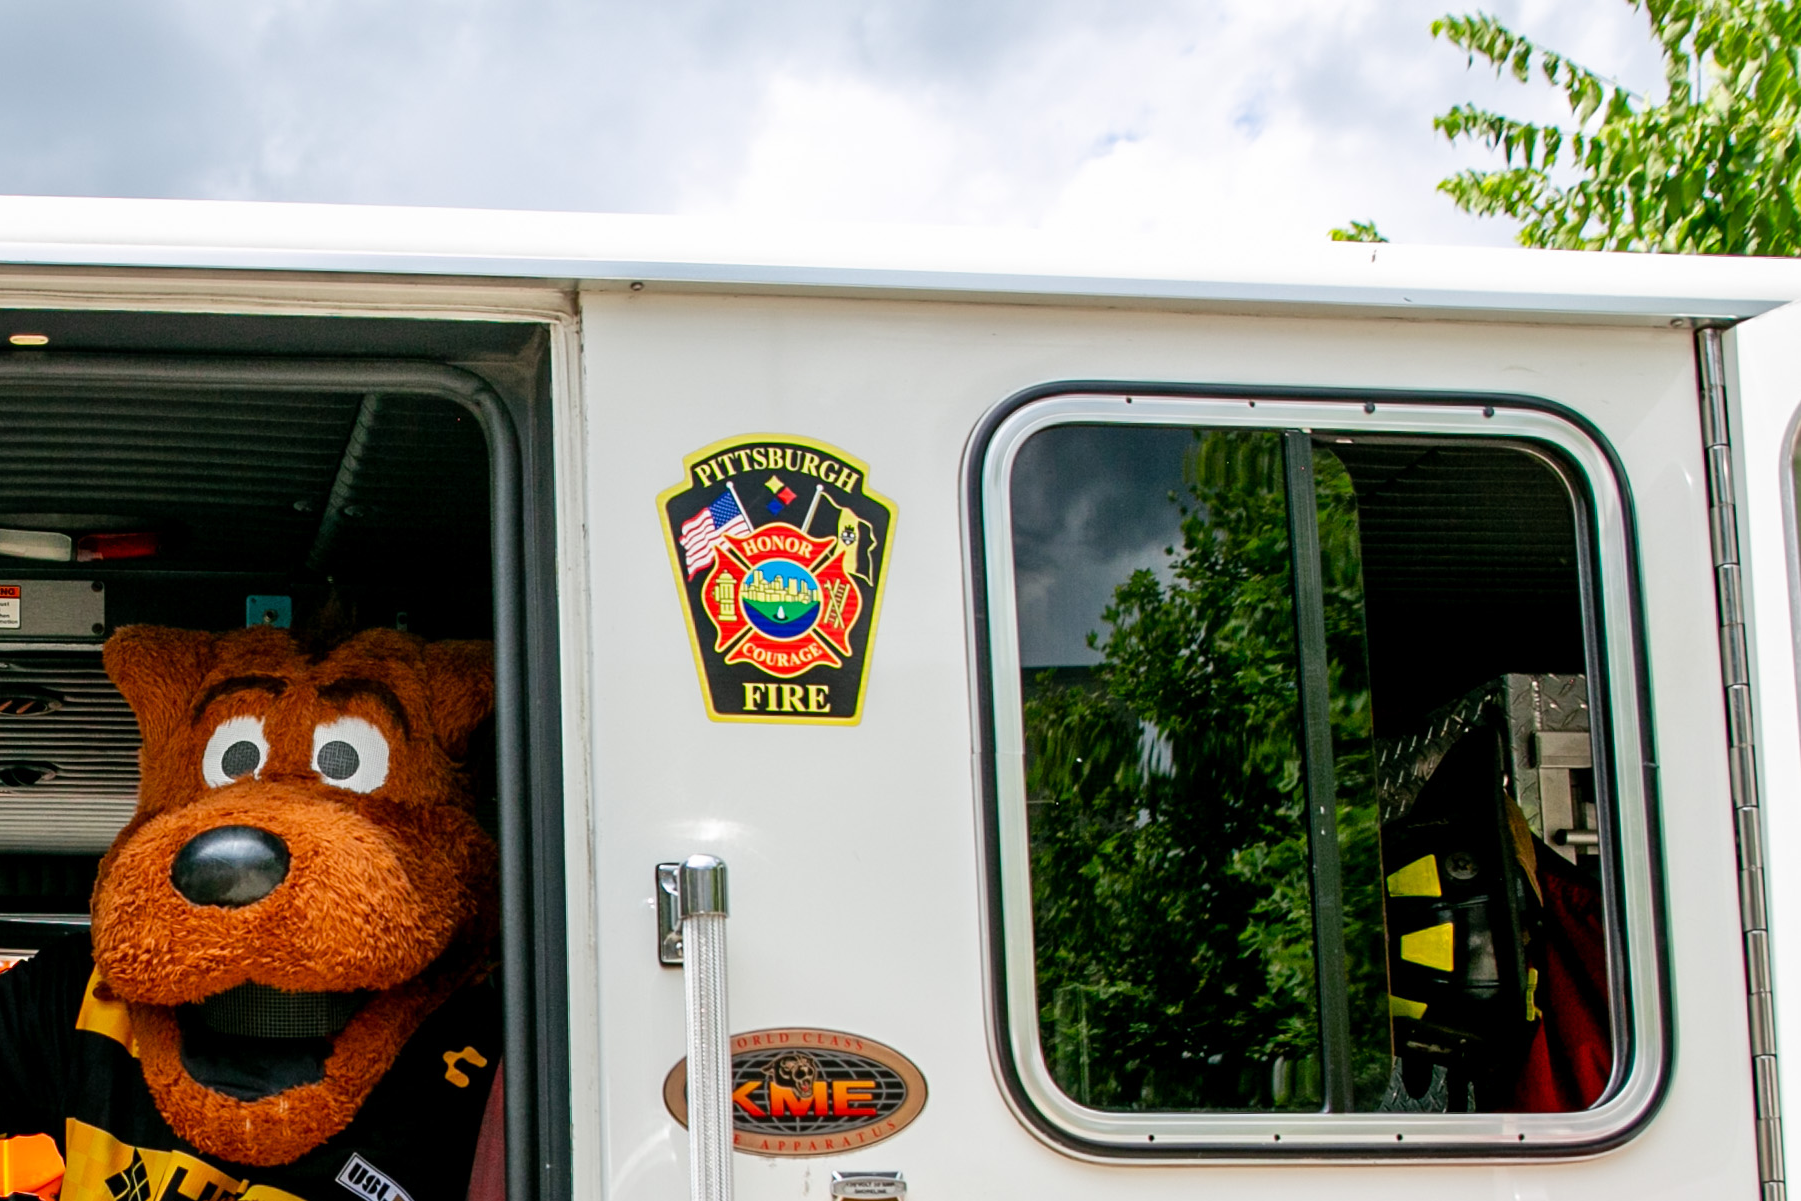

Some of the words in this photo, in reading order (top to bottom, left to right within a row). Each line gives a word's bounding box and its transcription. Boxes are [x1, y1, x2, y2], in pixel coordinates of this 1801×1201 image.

[694, 447, 860, 493] PITTSBURGH
[743, 535, 814, 560] HONOR
[741, 642, 824, 668] COURAGE
[742, 682, 831, 713] FIRE
[737, 1032, 789, 1050] ORLD
[802, 1032, 865, 1052] CLASS
[760, 1119, 898, 1152] APPARATUS
